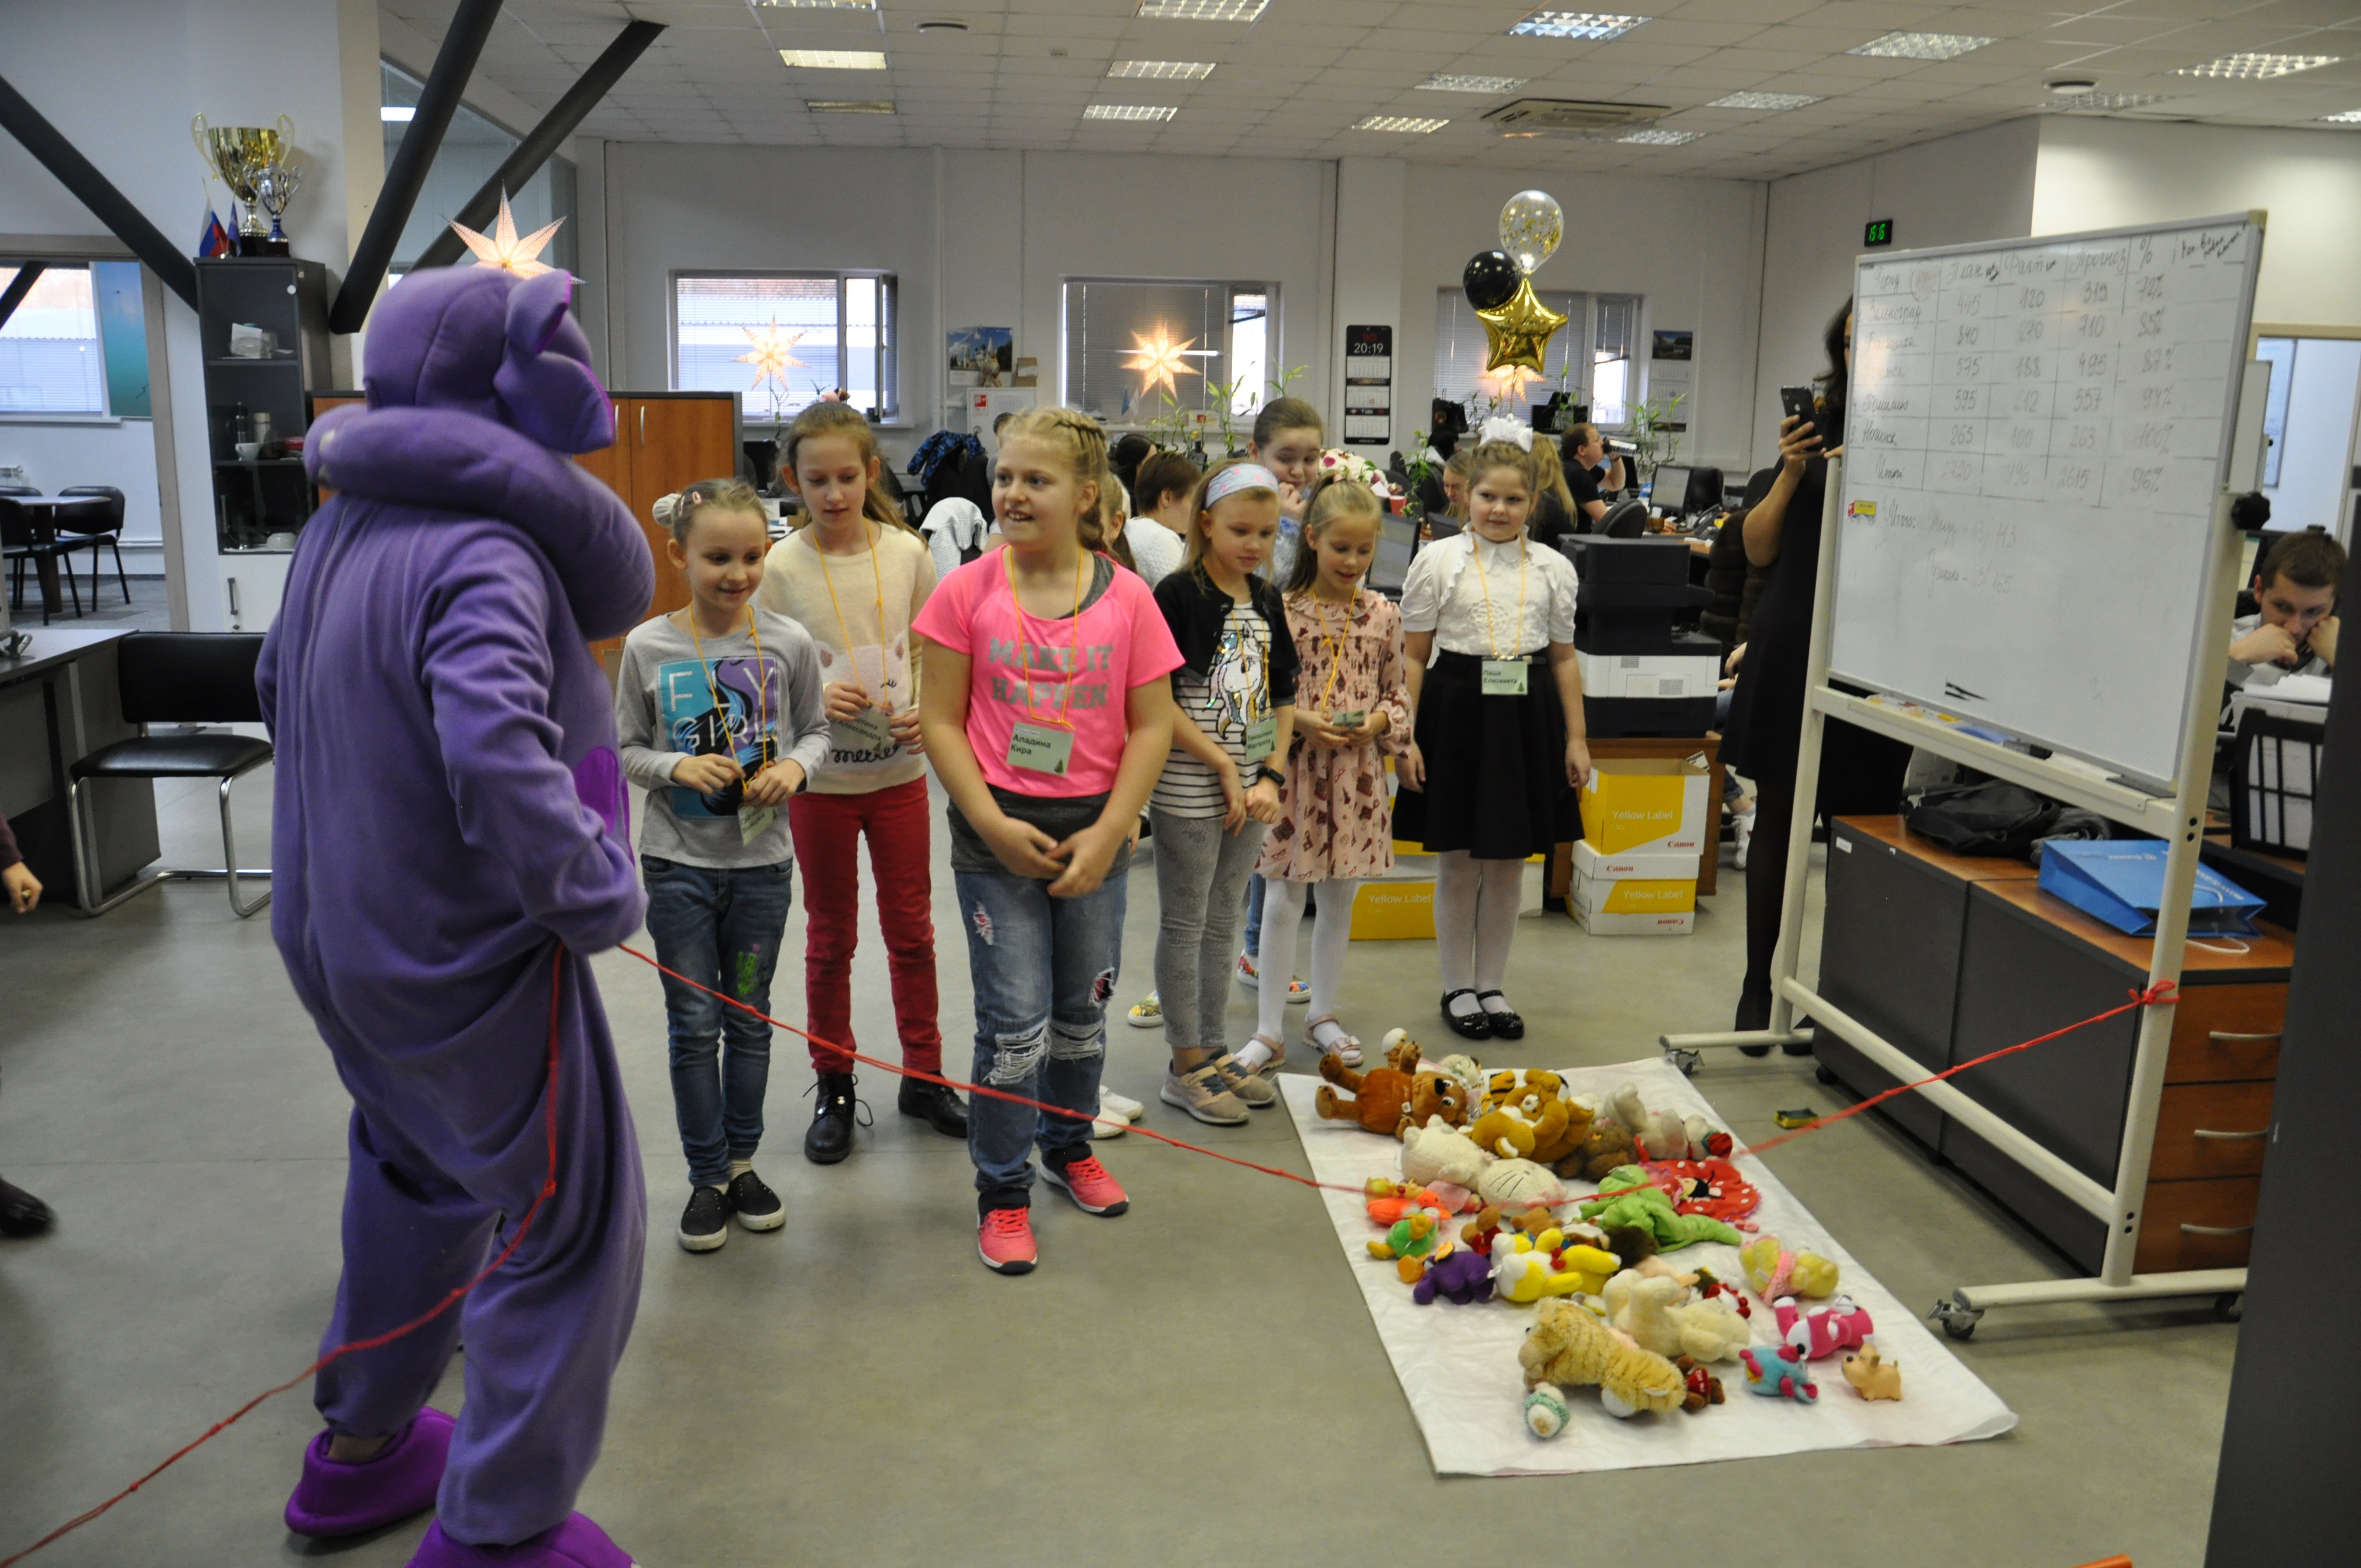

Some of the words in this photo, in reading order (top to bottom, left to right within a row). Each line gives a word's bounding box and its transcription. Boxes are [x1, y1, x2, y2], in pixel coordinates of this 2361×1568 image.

[2139, 235, 2153, 269] %
[1957, 292, 1981, 316] 445
[2019, 287, 2044, 309] 120
[1957, 325, 1978, 346] 840
[2079, 314, 2105, 337] 710
[1956, 357, 1982, 377] 575
[2016, 357, 2041, 378] 188
[1954, 388, 1977, 410] 595
[2014, 390, 2038, 413] 212
[2073, 387, 2102, 412] 557
[2143, 383, 2174, 409] 94%
[1950, 424, 1973, 445] 265
[2011, 427, 2033, 449] 100
[2138, 422, 2173, 455] 100%
[2131, 466, 2164, 497] 96%
[989, 637, 1077, 673] MAKE
[1085, 645, 1113, 671] IT
[669, 667, 774, 712] FLY
[991, 677, 1108, 709] HAPPEN
[673, 713, 771, 749] GIRL
[1013, 734, 1051, 748] Аладина
[1010, 743, 1032, 755] Кира
[1613, 810, 1646, 820] Yellow
[1647, 810, 1674, 820] Label
[1368, 895, 1402, 904] Yellow
[1404, 893, 1431, 903] Label
[1624, 890, 1655, 899] Yellow
[1657, 890, 1684, 899] Label
